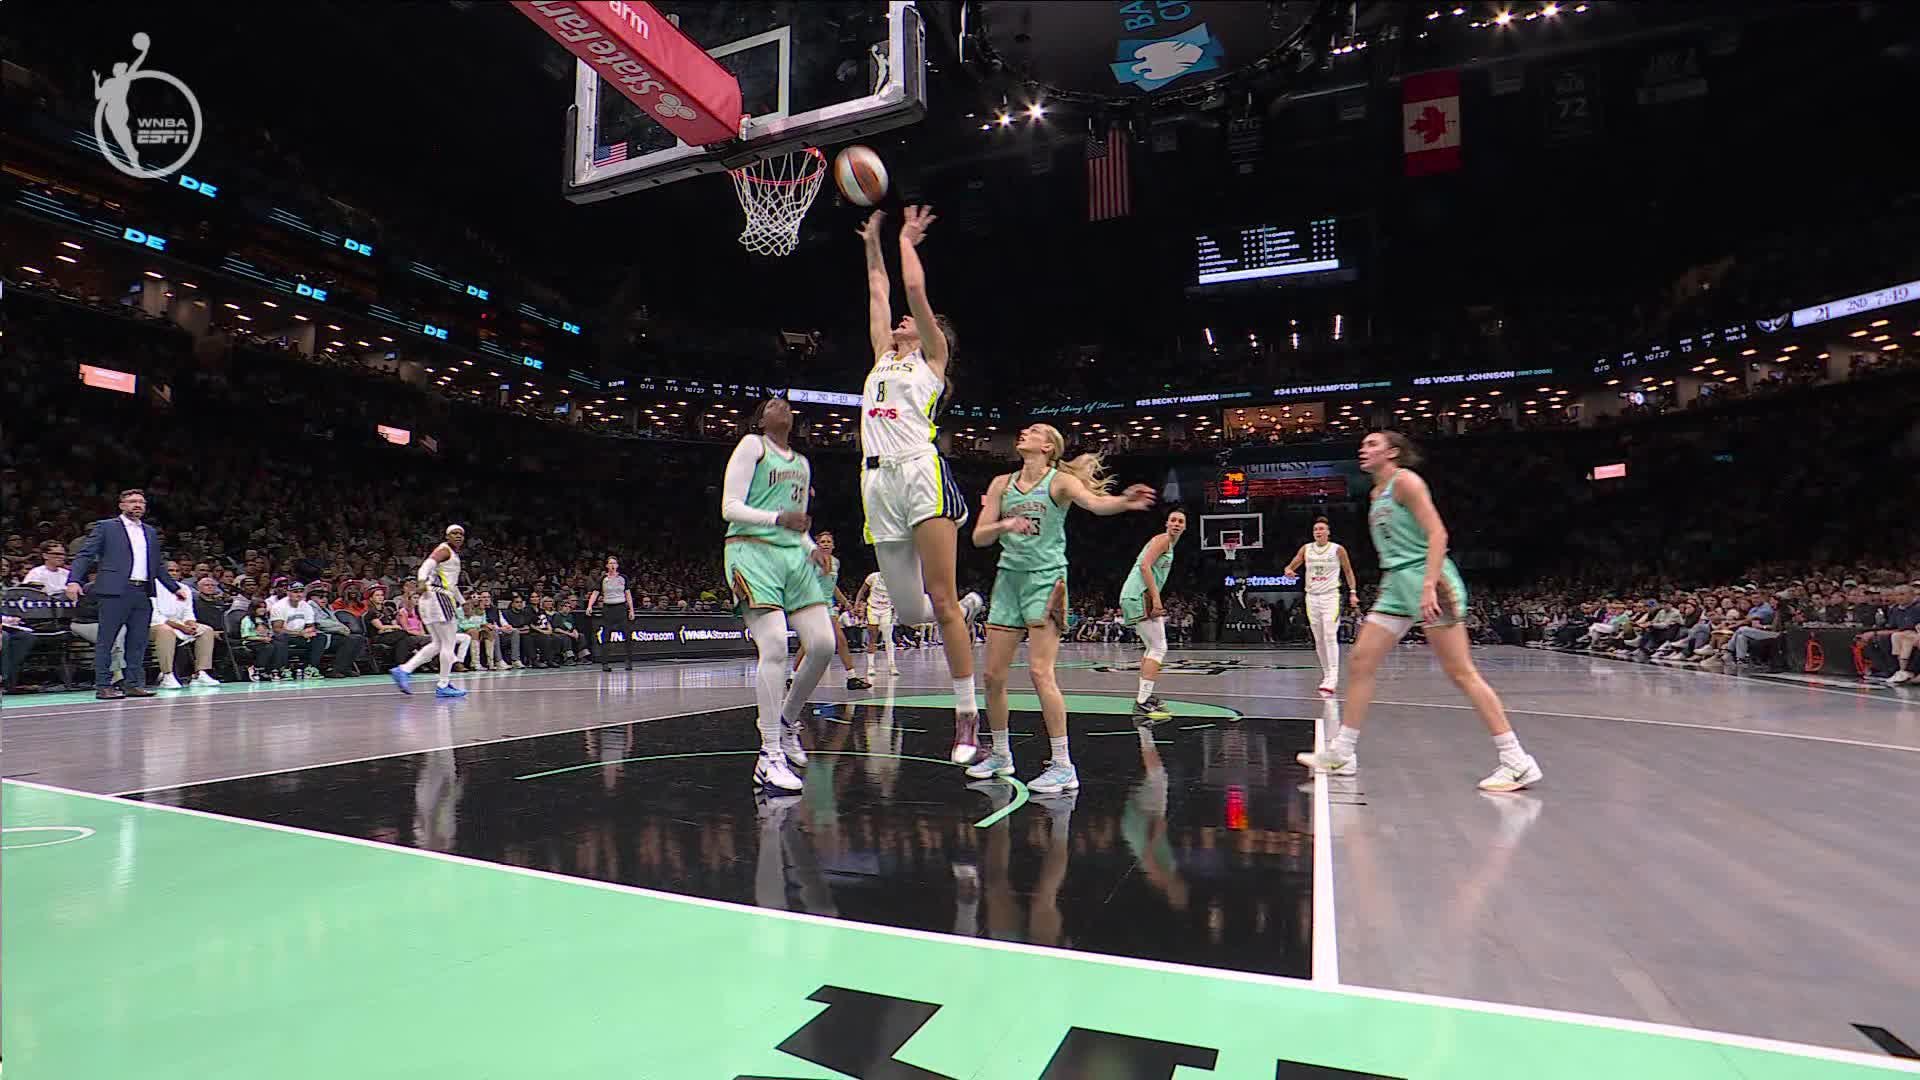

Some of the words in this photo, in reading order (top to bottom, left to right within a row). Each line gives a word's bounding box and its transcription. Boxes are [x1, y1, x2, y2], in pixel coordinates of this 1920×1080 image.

[179, 175, 218, 198] DE
[124, 228, 166, 251] DE
[344, 238, 373, 257] DE
[296, 283, 328, 302] DE
[466, 285, 489, 300] DE
[423, 324, 449, 340] DE
[562, 321, 581, 335] DE
[523, 356, 544, 370] DE
[1432, 375, 1464, 384] VICKIE
[1465, 371, 1515, 381] JOHNSON
[876, 381, 885, 402] 8
[1291, 387, 1313, 395] KYM
[1313, 383, 1359, 393] HAMPTON
[1152, 397, 1179, 405] BECKY
[1180, 394, 1219, 403] HAMMON
[685, 630, 742, 643] WNBAStore.com
